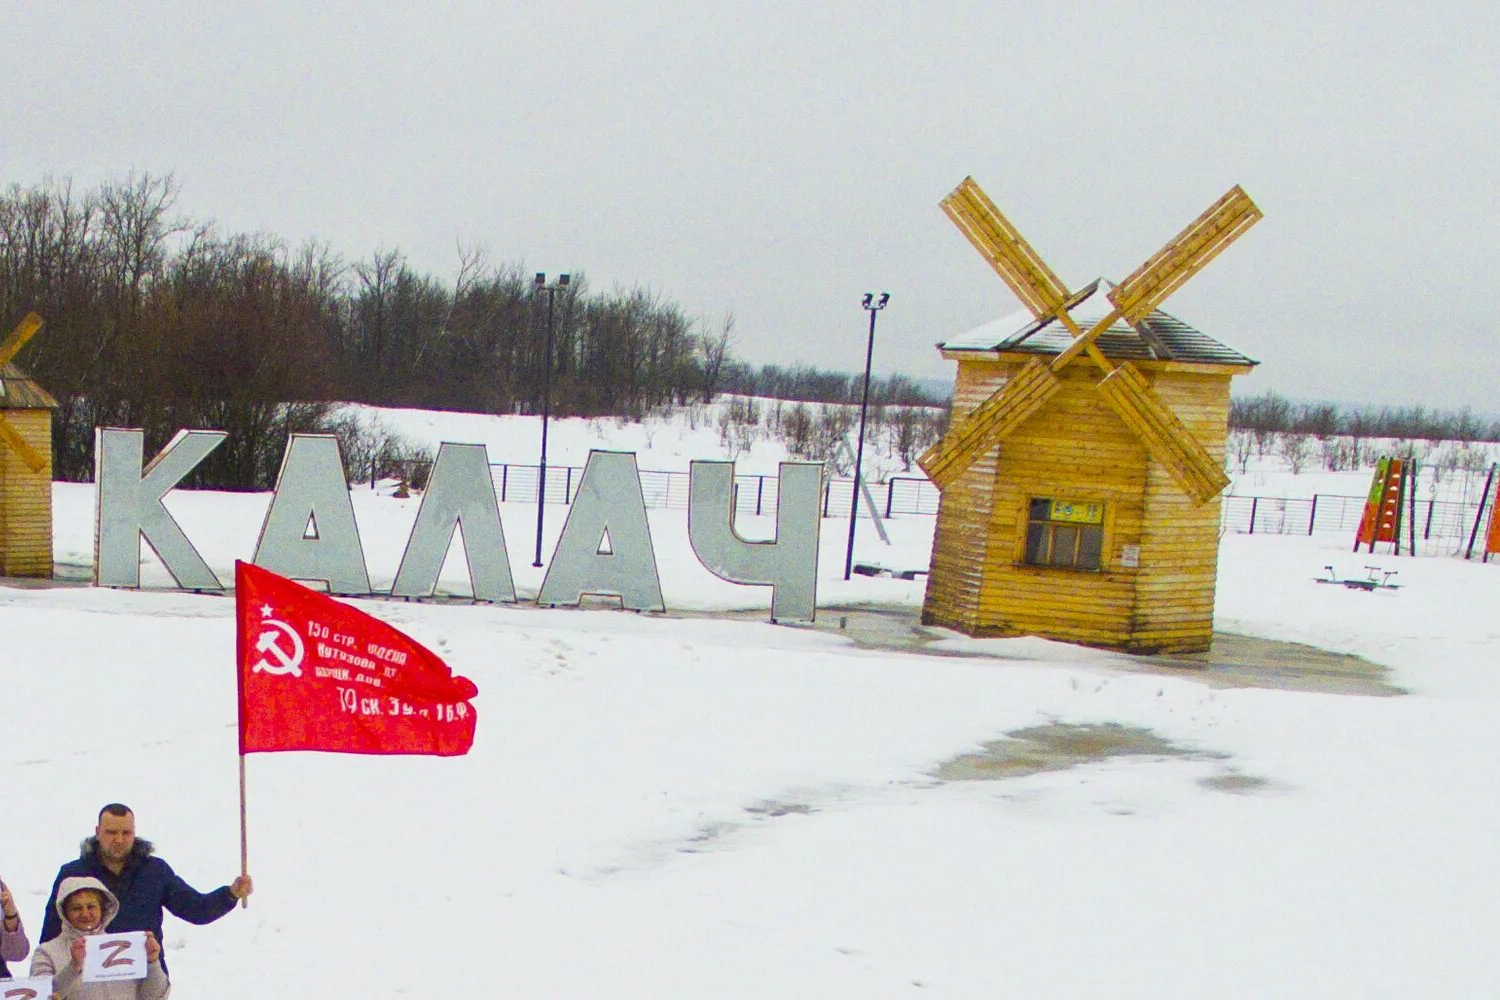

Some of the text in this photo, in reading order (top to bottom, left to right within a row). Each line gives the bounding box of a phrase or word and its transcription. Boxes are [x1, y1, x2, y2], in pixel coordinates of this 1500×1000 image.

[94, 426, 825, 622] КАЛАЧ
[308, 620, 330, 639] 150
[100, 940, 135, 969] Z
